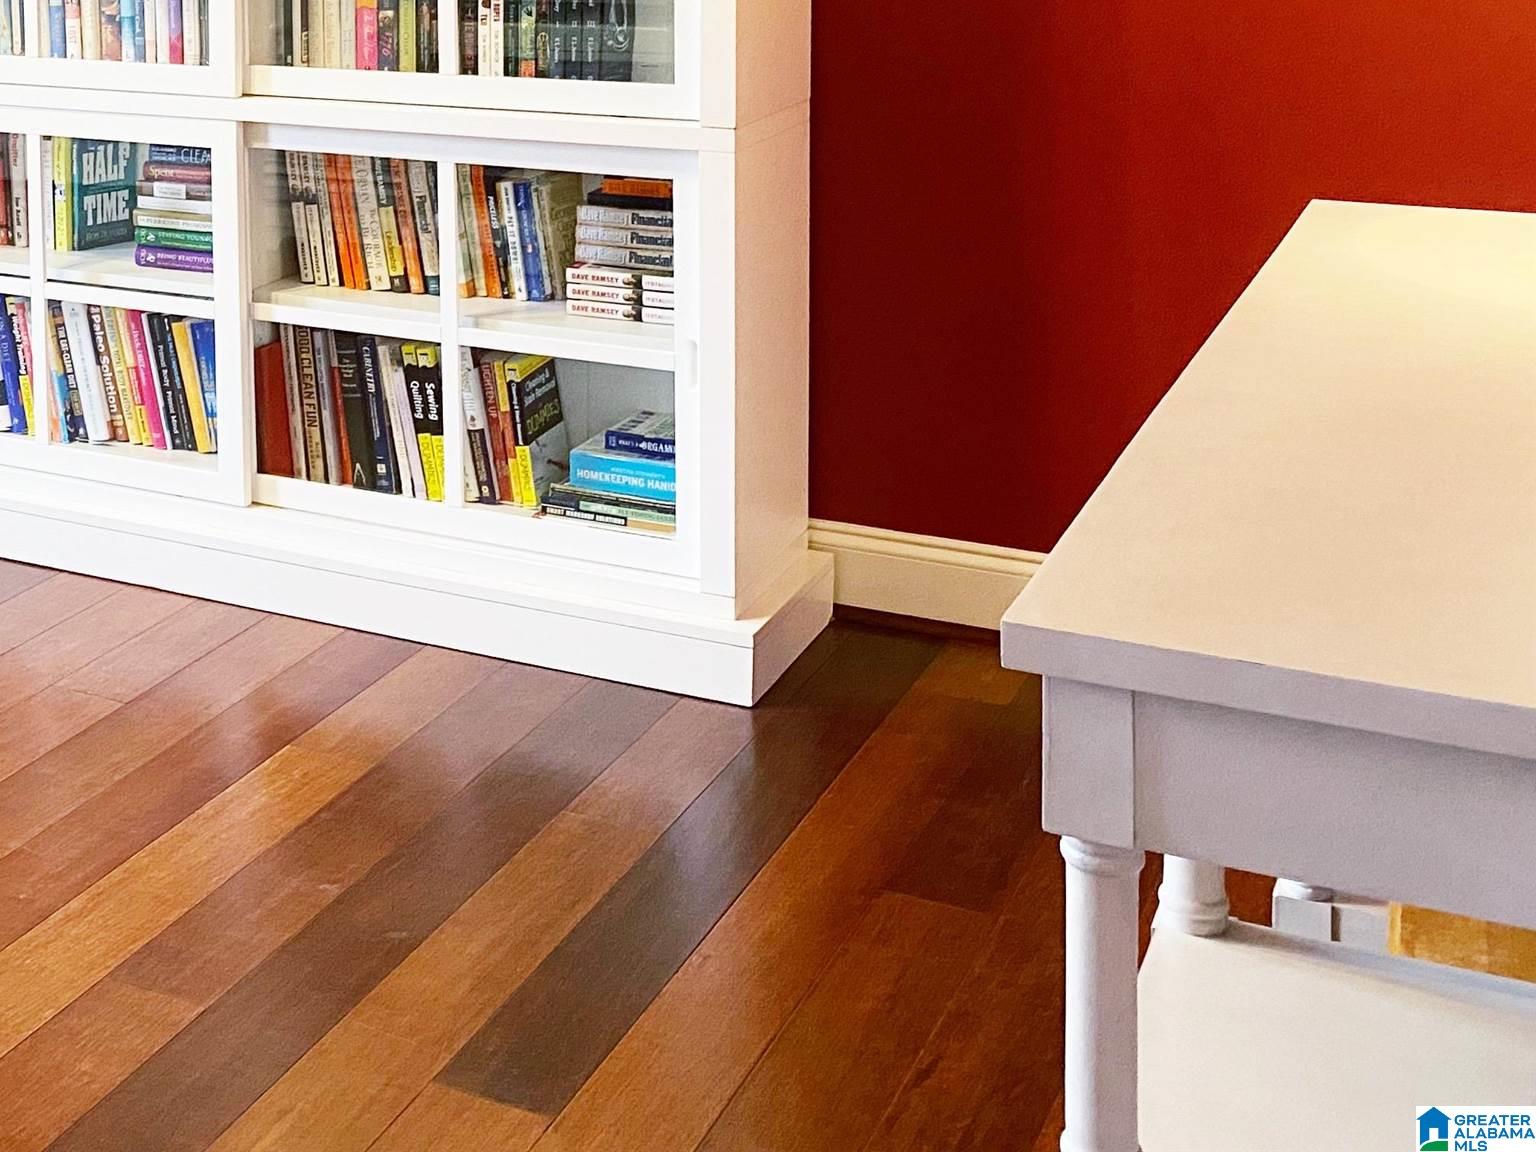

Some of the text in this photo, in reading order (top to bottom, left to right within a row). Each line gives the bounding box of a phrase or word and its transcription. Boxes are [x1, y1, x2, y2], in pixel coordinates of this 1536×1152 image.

[381, 32, 393, 56] 1776
[82, 143, 130, 186] HALF
[148, 165, 174, 180] Spent
[83, 189, 130, 226] TIME
[488, 195, 499, 230] PRICELESS
[631, 211, 674, 228] Financia
[630, 231, 674, 247] Financia
[178, 254, 213, 265] BEAUTIFU
[571, 273, 590, 281] DAVE
[591, 274, 619, 284] RAMSEY
[571, 288, 590, 296] DAVE
[591, 290, 620, 299] RAMSEY
[571, 304, 619, 316] DAVE RAMSEY
[58, 326, 68, 339] THE
[1, 342, 10, 363] DIET
[12, 316, 28, 375] Weight Training
[60, 339, 76, 374] EAT-CLEAN
[91, 314, 119, 412] Paleo Solution
[361, 346, 376, 393] CABINETRY
[300, 358, 315, 400] CLEAN
[482, 364, 494, 404] LIGHTEN
[409, 380, 424, 419] Quilting
[425, 382, 439, 421] Sewing
[169, 415, 179, 434] Mind
[306, 403, 318, 428] FUN
[576, 467, 645, 488] HOMEKEEPING
